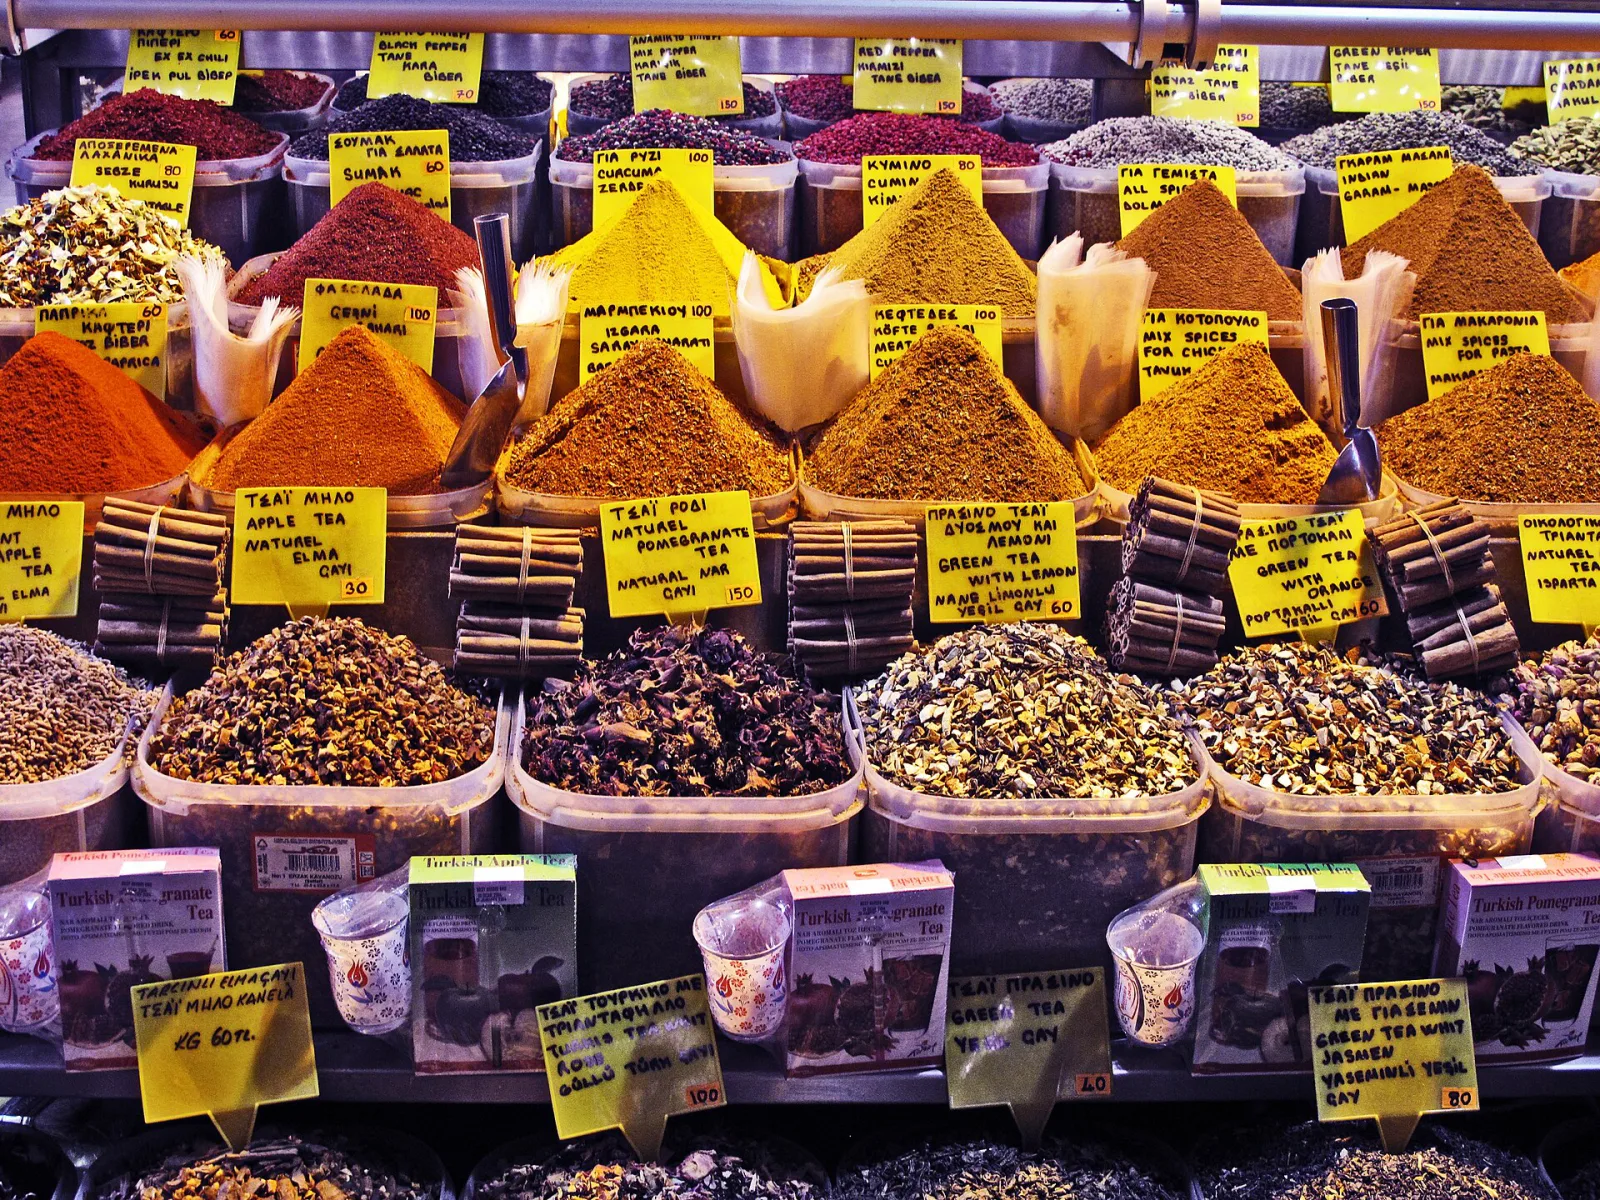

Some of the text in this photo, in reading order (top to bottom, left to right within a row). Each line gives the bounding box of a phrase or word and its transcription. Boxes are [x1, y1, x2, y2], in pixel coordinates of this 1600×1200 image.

[219, 30, 236, 39] 60
[378, 41, 467, 52] BLACK PEPPER
[633, 49, 653, 58] MIX
[858, 47, 937, 58] RED PEPPER
[1334, 47, 1431, 57] GREEN PEPPER
[198, 54, 228, 62] CHILI
[378, 52, 412, 62] TANE
[402, 61, 437, 71] KARA
[1335, 62, 1370, 71] TANE
[169, 71, 191, 81] PUL
[636, 73, 667, 82] TANE
[871, 74, 903, 84] TANE
[1154, 76, 1239, 89] BEYAZ TANE
[457, 90, 474, 99] 70
[720, 101, 738, 110] 150
[938, 101, 956, 111] 150
[1419, 100, 1436, 109] 150
[1236, 113, 1254, 122] 150
[688, 152, 709, 163] 100
[95, 165, 181, 176] SEBZE 80
[426, 161, 444, 173] 60
[958, 161, 975, 171] 80
[344, 166, 401, 181] SUMAK
[1342, 169, 1389, 185] INDIAN
[129, 179, 179, 189] KURUSU
[868, 177, 919, 188] CUMIN
[1124, 185, 1148, 195] ALL
[143, 304, 161, 317] 60
[410, 307, 430, 320] 100
[692, 305, 712, 317] 100
[975, 309, 996, 320] 100
[606, 324, 660, 338] IZGARA
[874, 323, 917, 336] KÖFTE
[1143, 331, 1237, 343] MIX SPICES
[1426, 334, 1508, 348] MIX SPICES
[875, 340, 912, 354] MEAT
[1144, 346, 1173, 357] FOR
[1458, 349, 1482, 361] FOR
[246, 512, 346, 531] APPLE TEA
[612, 519, 688, 541] NATUREL
[245, 536, 323, 552] NATUREL
[637, 527, 750, 554] POMEGRANATE
[292, 548, 339, 564] ELMA
[694, 543, 730, 558] TEA
[1527, 548, 1594, 561] NATUREL
[939, 552, 1040, 573] GREEN TEA
[1257, 550, 1357, 577] GREEN TEA
[1570, 561, 1600, 573] TEA
[21, 563, 52, 578] TEA
[618, 563, 730, 591] NATURAL NAR
[968, 566, 1077, 587] WITH LEMON
[345, 581, 368, 595] 30
[1282, 572, 1323, 592] WITH
[1308, 576, 1373, 600] ORANGE
[12, 586, 49, 600] ELMA
[729, 586, 753, 601] 150
[935, 592, 980, 606] NANE
[1051, 601, 1073, 615] 60
[1360, 600, 1379, 616] 60
[62, 853, 108, 862] Turkish
[423, 857, 482, 868] Turkish
[539, 855, 566, 866] Tea
[1210, 865, 1272, 877] Turkish
[1322, 863, 1353, 875] Tea
[56, 889, 113, 907] Turkish
[536, 887, 565, 907] Tea
[187, 904, 214, 920] Tea
[1474, 897, 1524, 913] Turkish
[797, 909, 852, 927] Turkish
[919, 920, 944, 936] Tea
[219, 973, 257, 988] ELMA
[952, 1000, 1065, 1025] GREEN TEA
[174, 1032, 201, 1051] KG
[1316, 1029, 1375, 1048] GREEN
[1381, 1024, 1416, 1041] TEA
[1322, 1045, 1394, 1065] JASMEN
[689, 1088, 719, 1105] 100
[1448, 1091, 1471, 1106] 80
